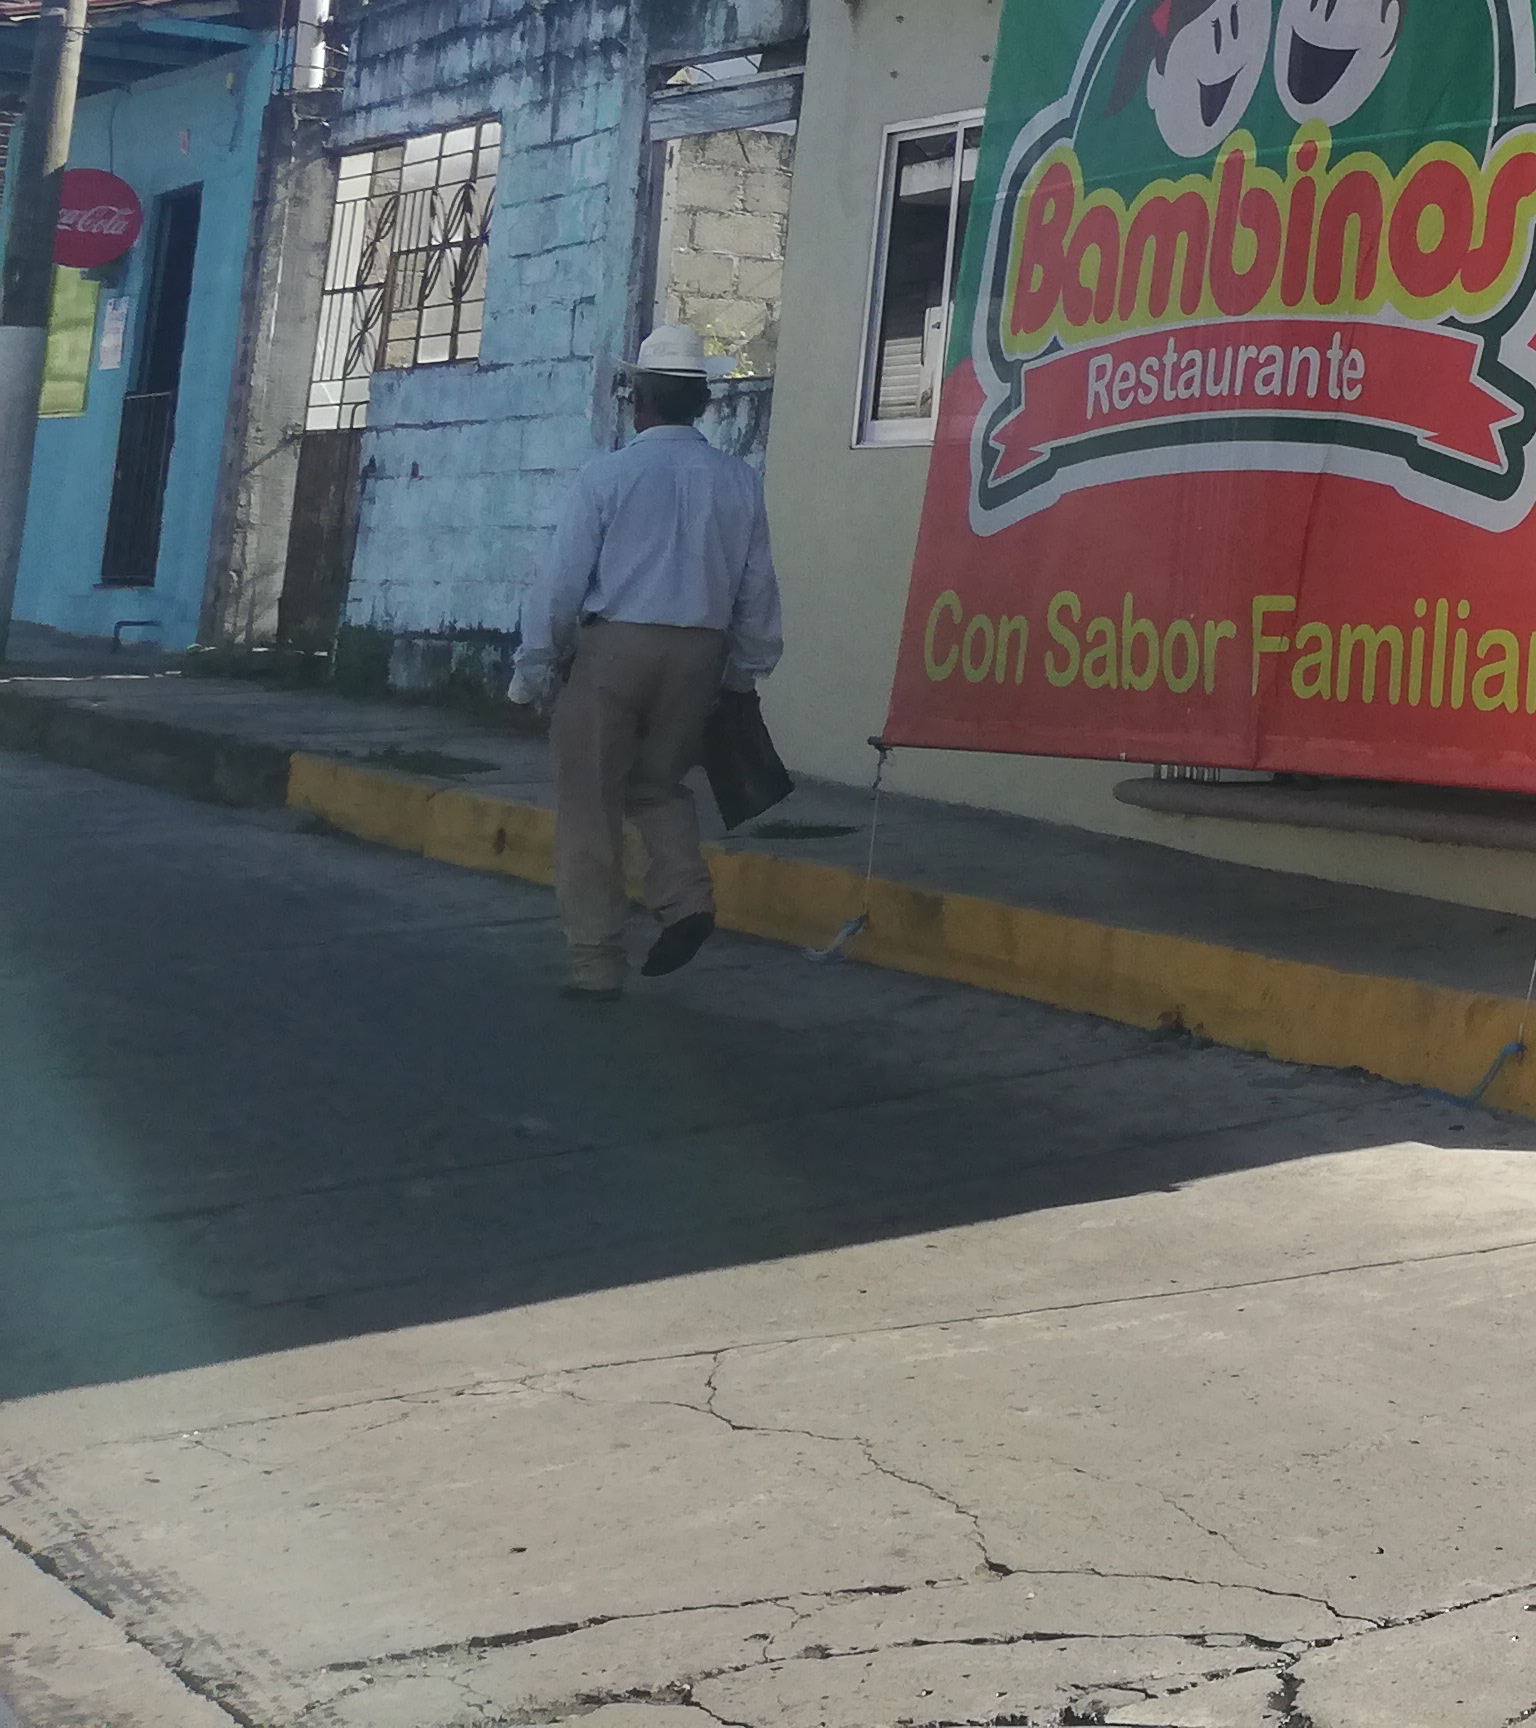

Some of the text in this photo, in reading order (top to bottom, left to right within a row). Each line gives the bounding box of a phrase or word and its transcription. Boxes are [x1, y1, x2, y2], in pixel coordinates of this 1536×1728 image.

[1085, 330, 1366, 420] Restaurante
[922, 589, 1028, 687] Con
[1043, 590, 1237, 695] Sabor
